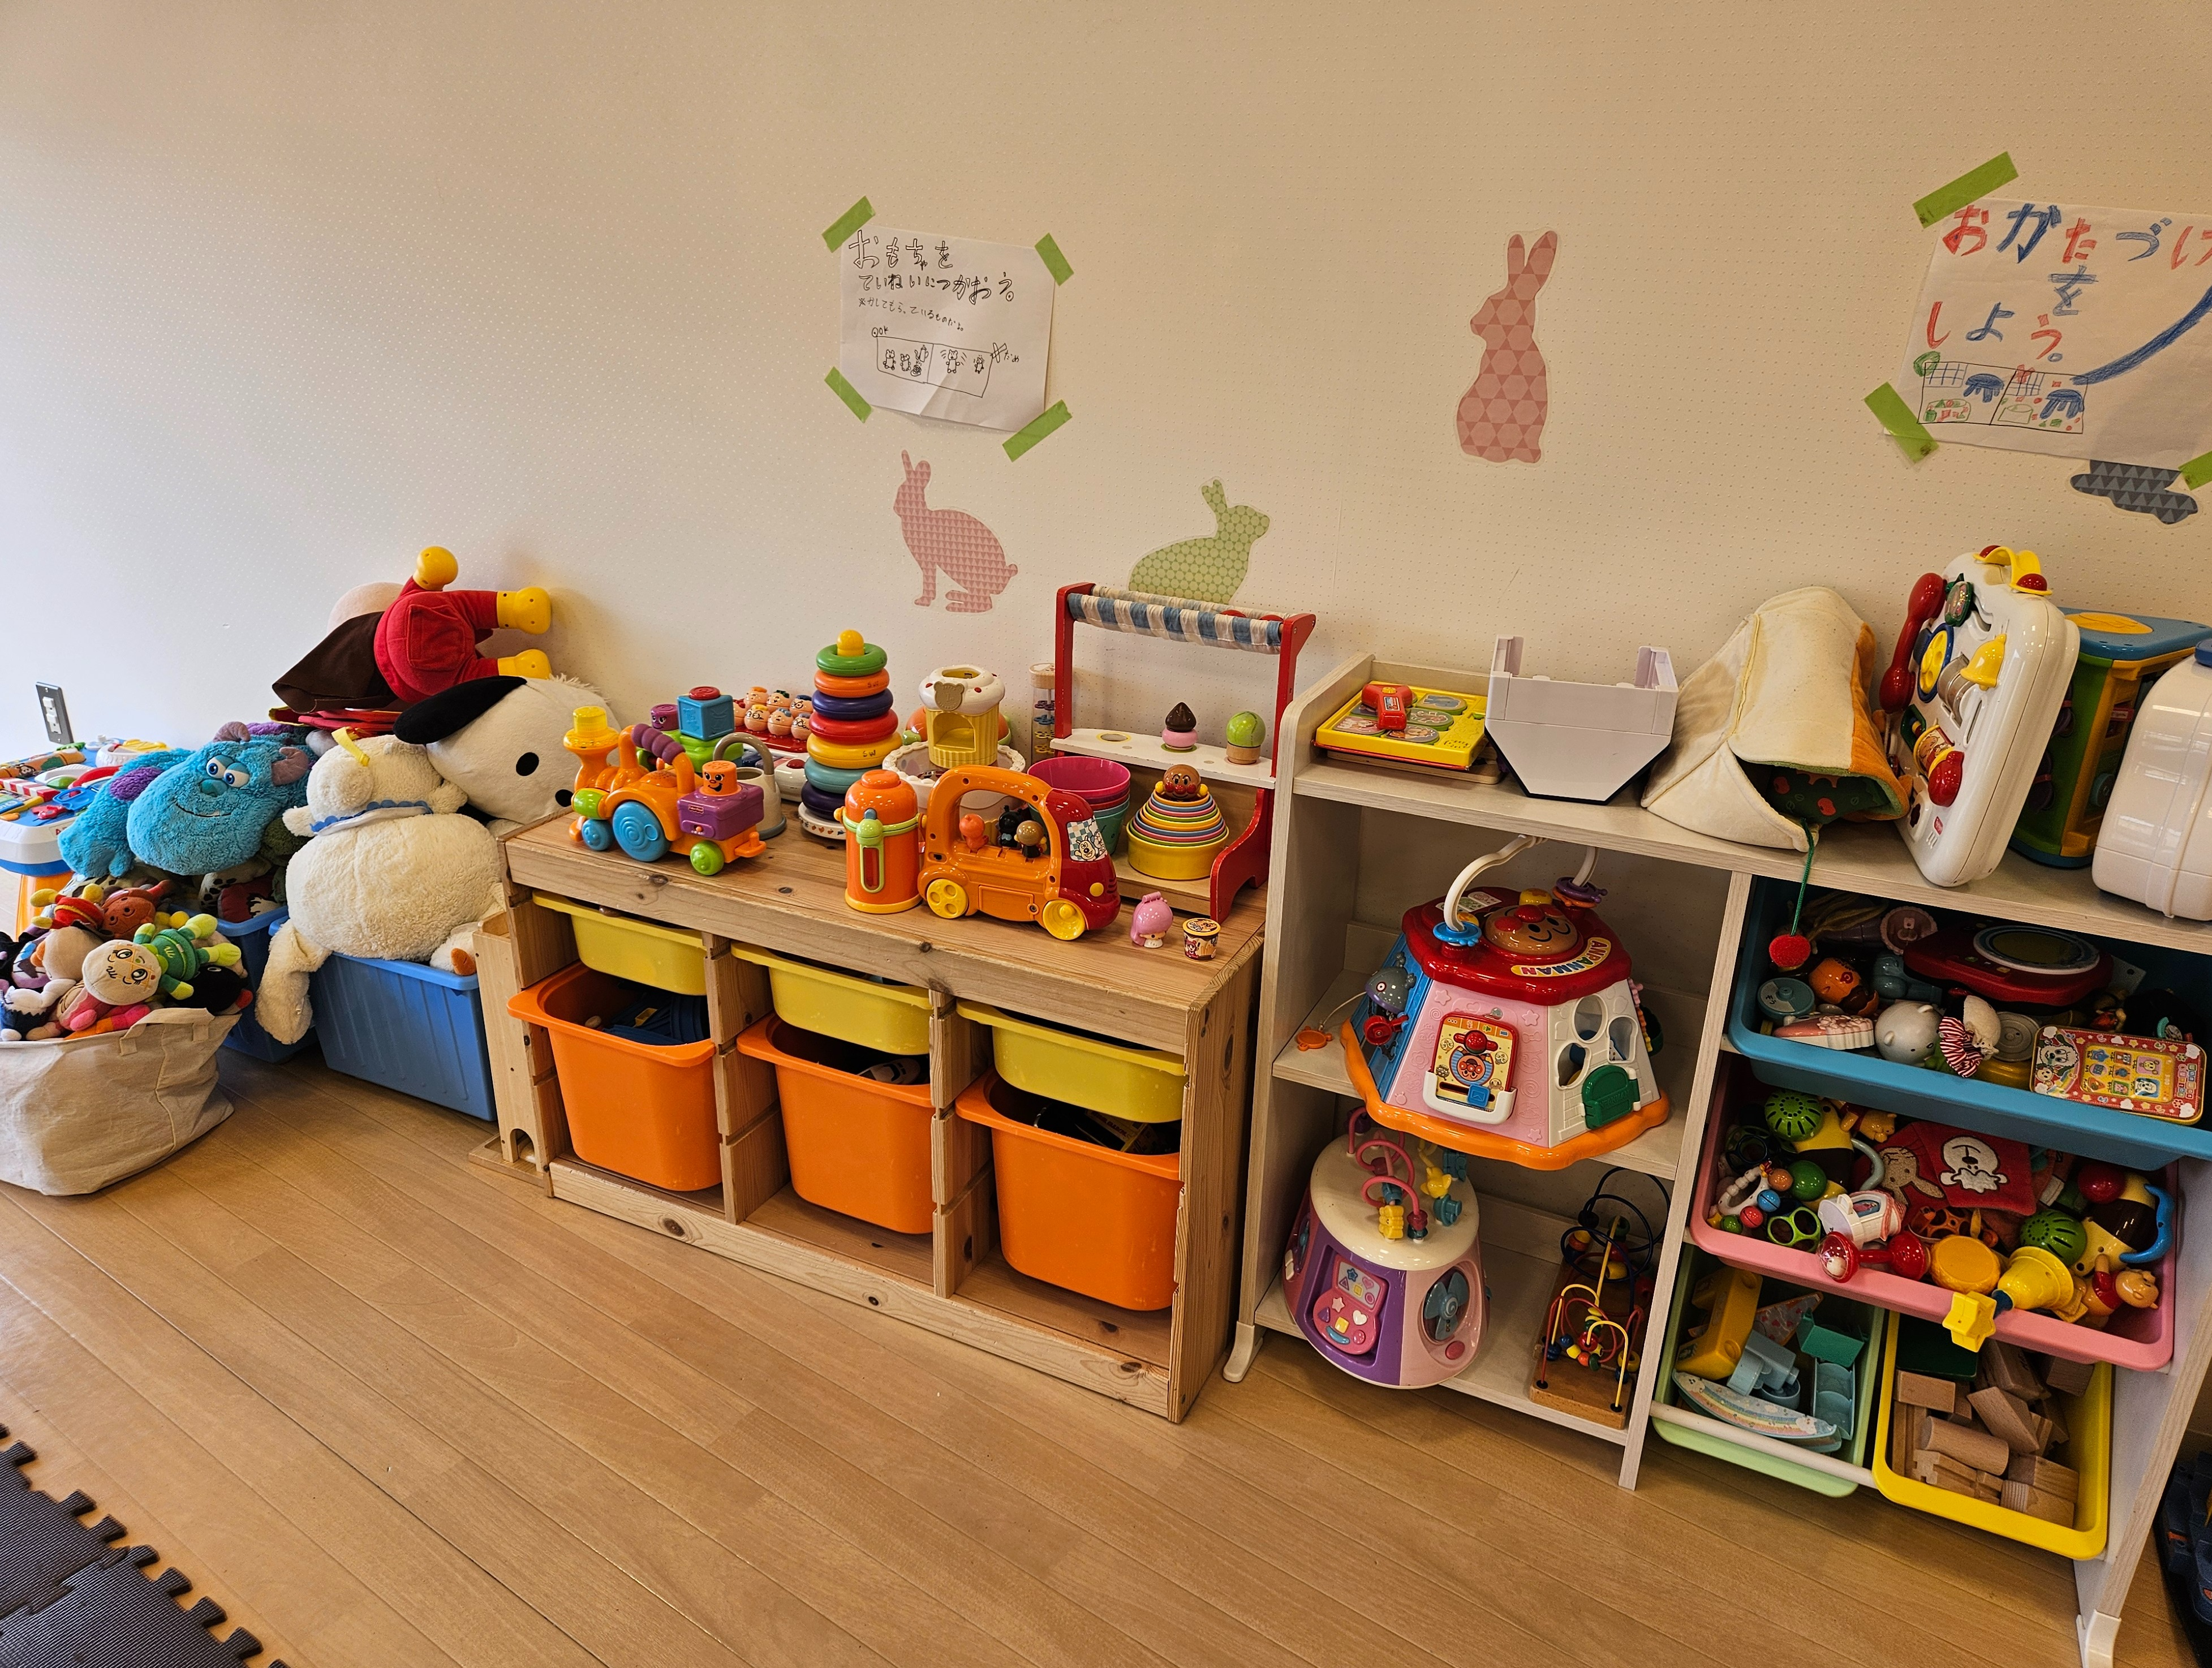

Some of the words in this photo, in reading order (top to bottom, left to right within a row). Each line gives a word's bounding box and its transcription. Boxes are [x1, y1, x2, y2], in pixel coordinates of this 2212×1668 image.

[849, 229, 953, 271] おもちゃを
[2047, 264, 2099, 317] を
[1521, 940, 1609, 975] ANPANMAN
